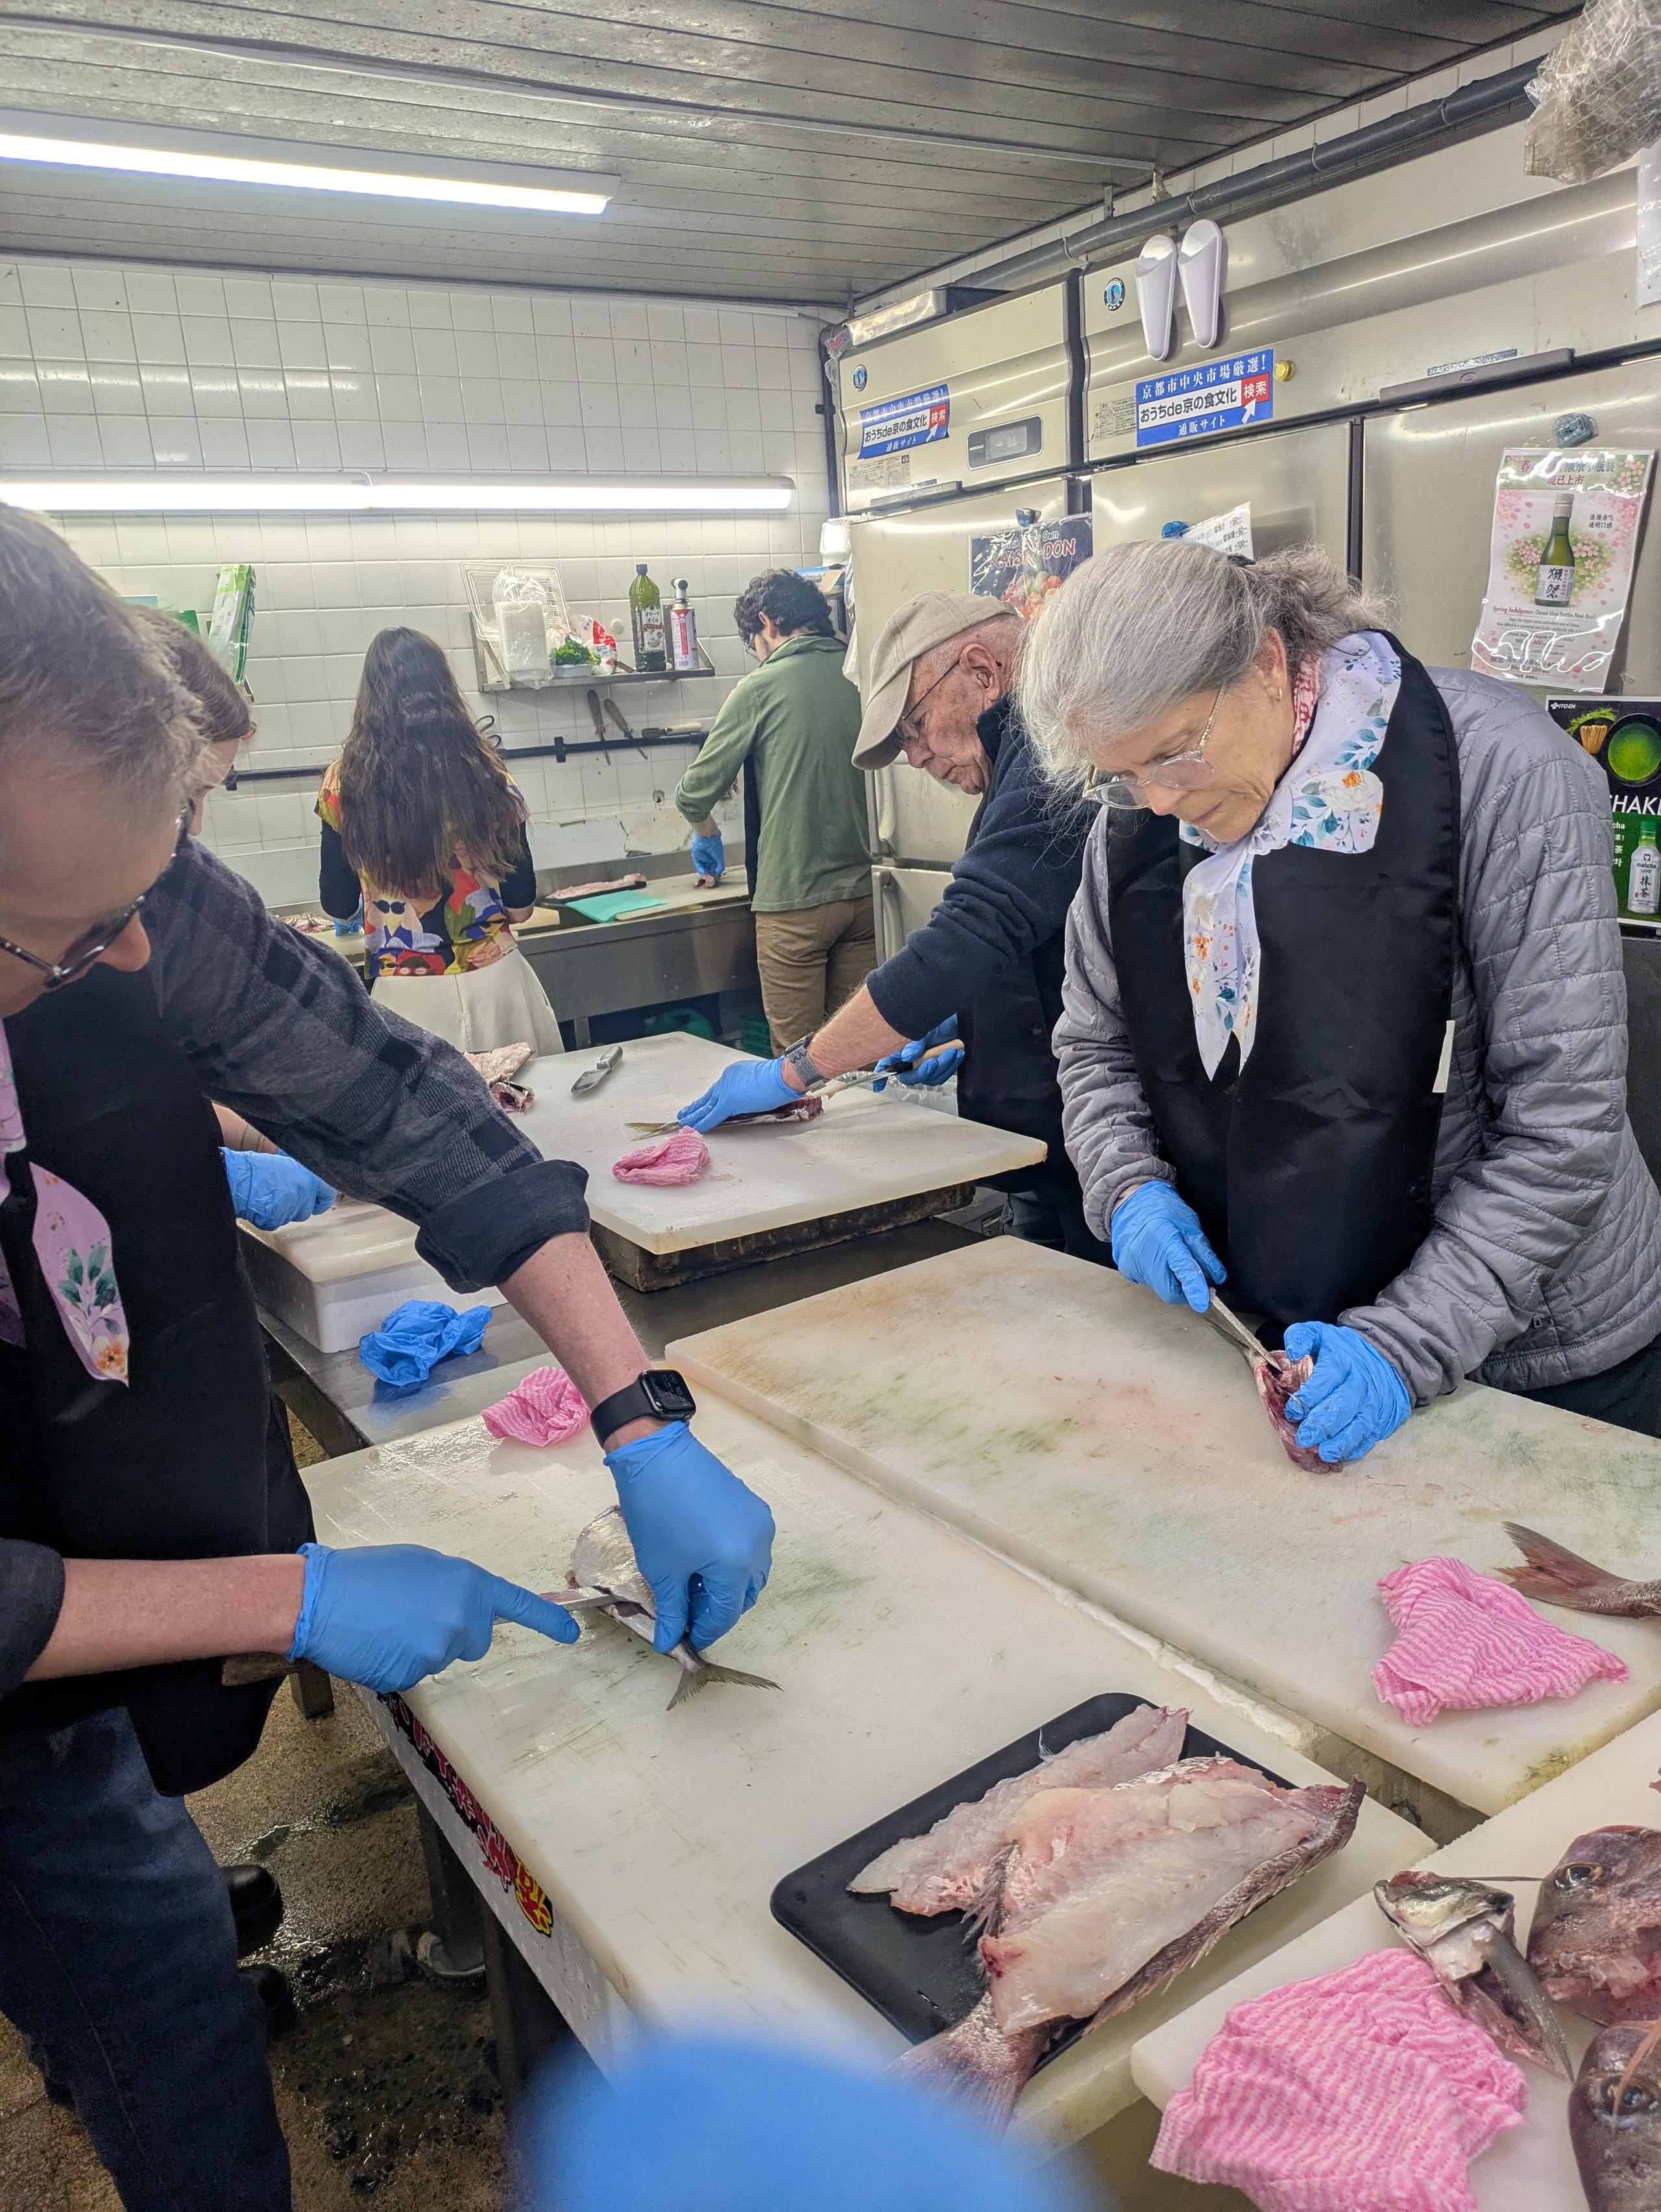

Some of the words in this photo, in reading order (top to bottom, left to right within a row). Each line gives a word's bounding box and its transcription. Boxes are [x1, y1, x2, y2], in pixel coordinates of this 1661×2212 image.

[1141, 387, 1237, 423] おうちde京の食文化
[1243, 381, 1267, 399] 検索
[865, 414, 927, 443] おうちde京の食文化
[931, 411, 946, 422] 検索
[1178, 415, 1225, 436] 通販サイト
[1042, 530, 1059, 541] Own
[1610, 795, 1661, 816] HAK
